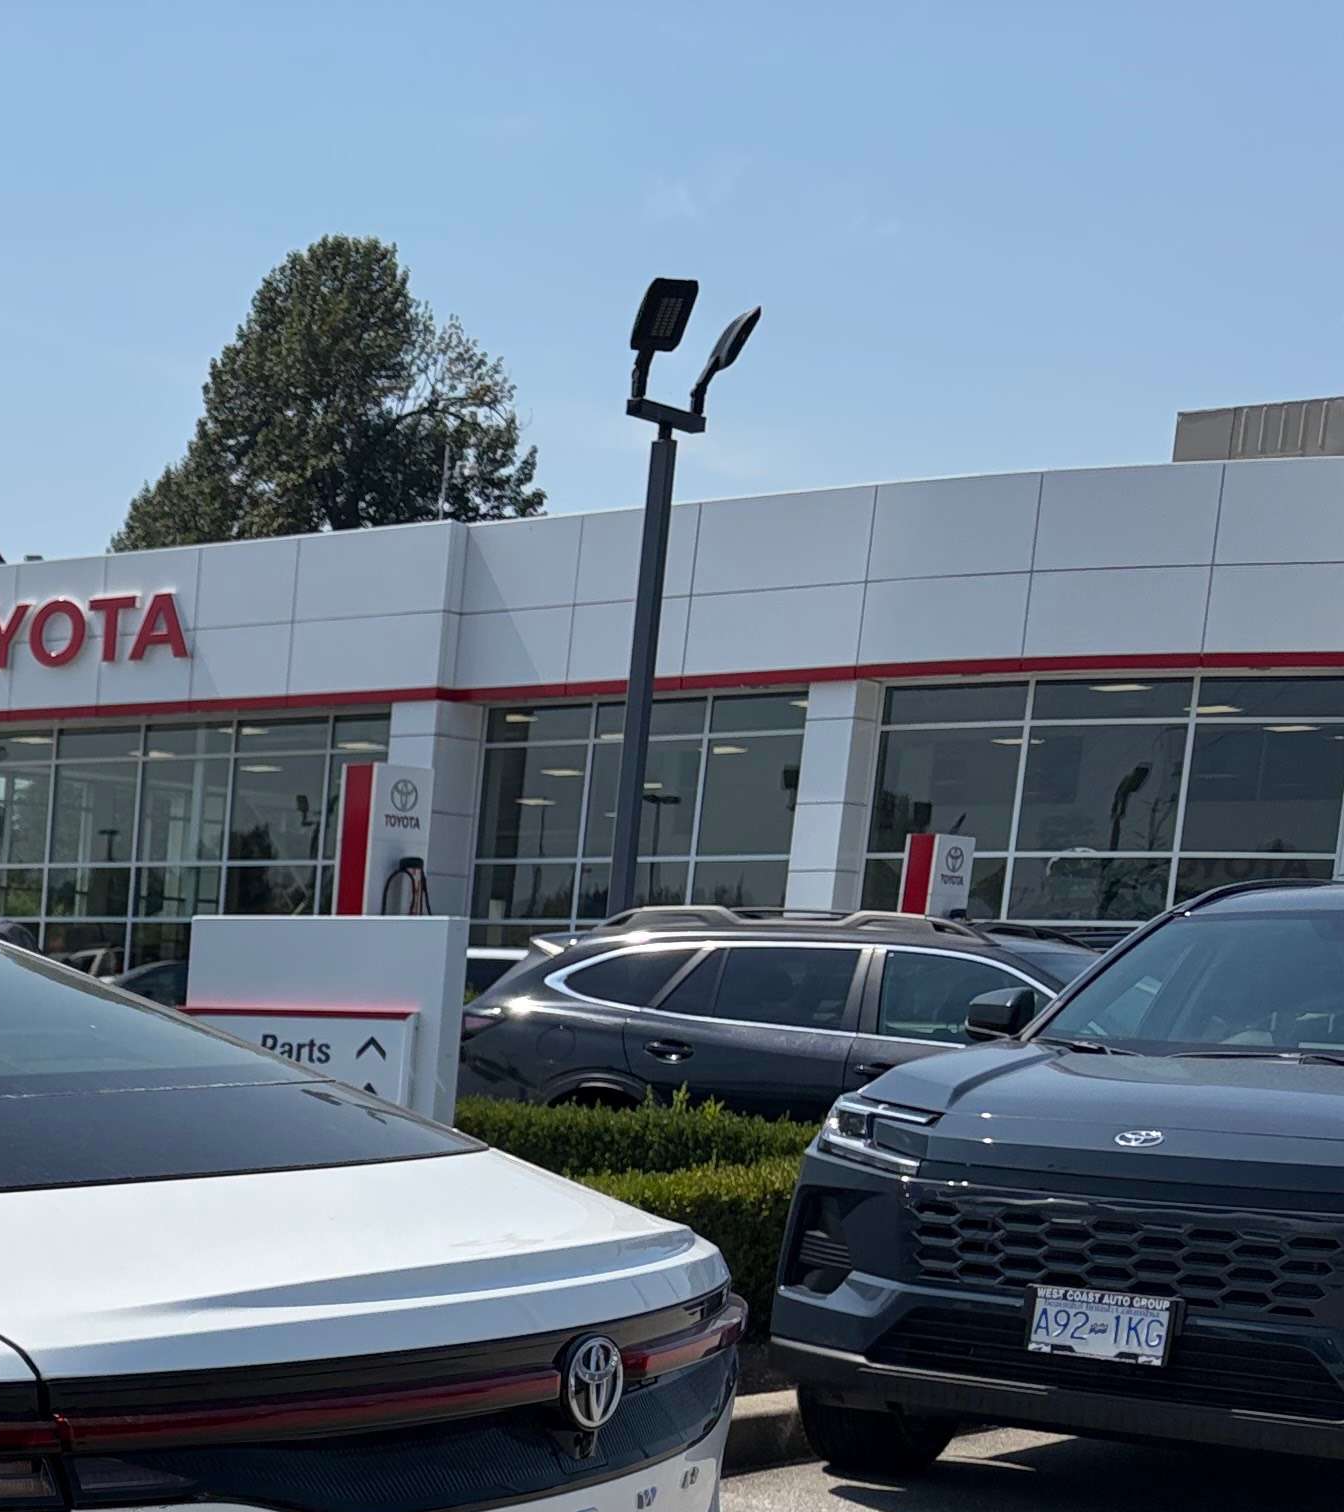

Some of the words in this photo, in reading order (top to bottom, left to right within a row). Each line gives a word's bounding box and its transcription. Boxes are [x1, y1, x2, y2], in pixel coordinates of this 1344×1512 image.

[384, 814, 420, 830] TOYOTA
[262, 1034, 331, 1064] Parts
[1037, 1287, 1066, 1299] WEST
[1067, 1289, 1101, 1303] COAST
[1102, 1295, 1131, 1307] AUTO
[1133, 1297, 1170, 1311] GROUP
[1034, 1307, 1089, 1341] A92
[1113, 1315, 1164, 1348] 1KG
